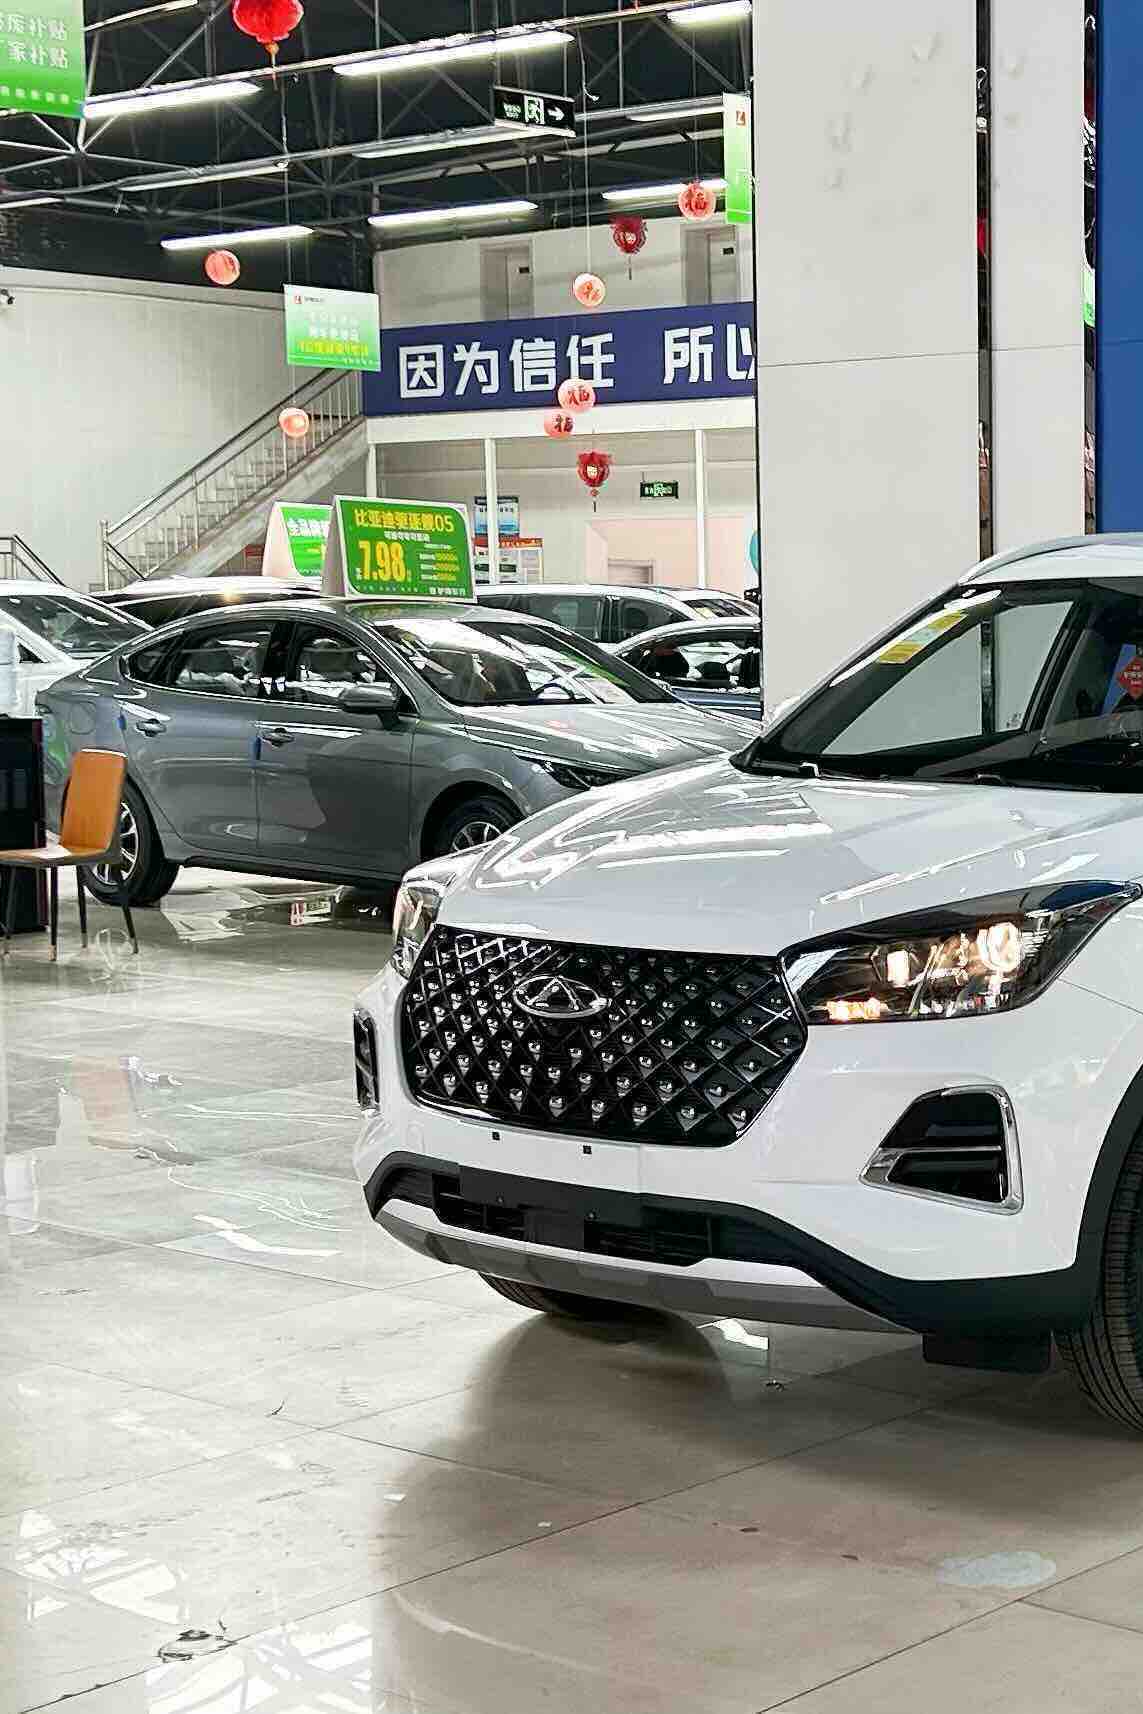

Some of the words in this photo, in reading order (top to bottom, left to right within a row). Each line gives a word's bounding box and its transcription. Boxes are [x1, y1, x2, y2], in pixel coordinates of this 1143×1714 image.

[0, 40, 69, 69] 家补贴
[398, 331, 615, 399] 因为信任
[357, 539, 407, 583] 7.98
